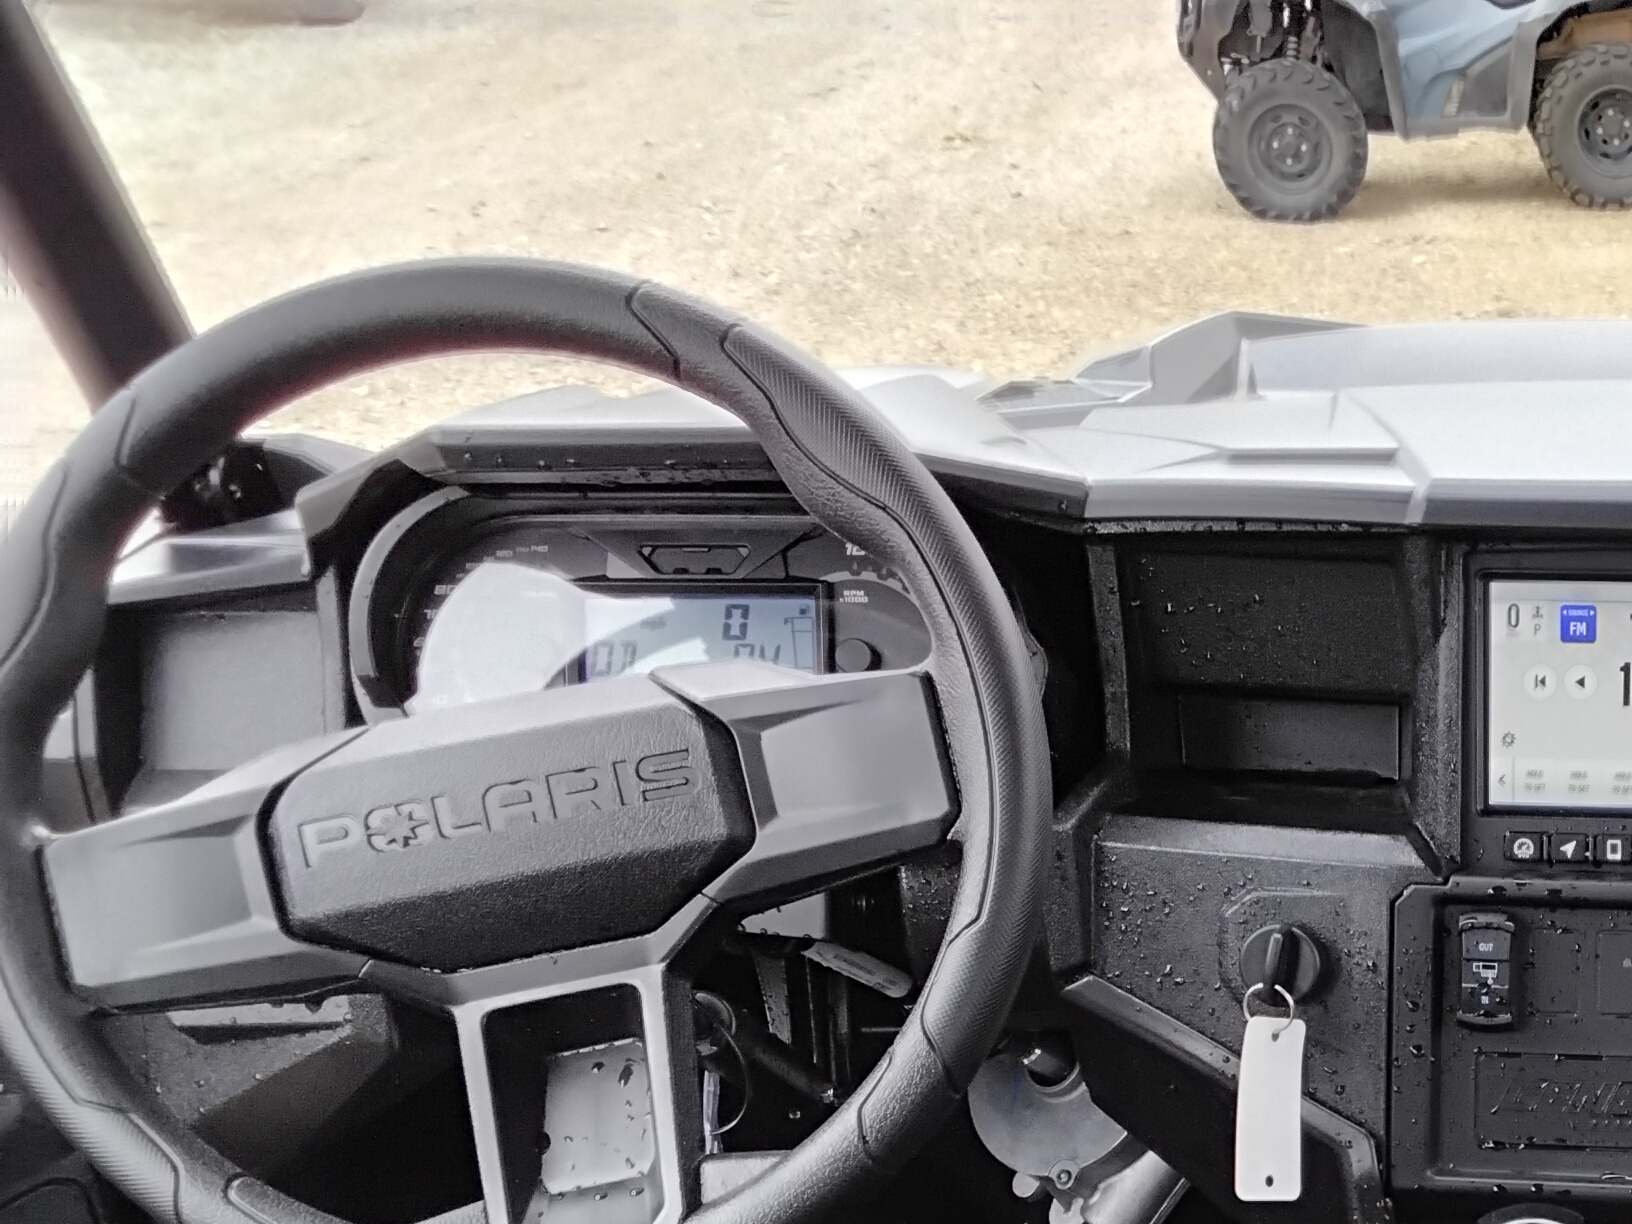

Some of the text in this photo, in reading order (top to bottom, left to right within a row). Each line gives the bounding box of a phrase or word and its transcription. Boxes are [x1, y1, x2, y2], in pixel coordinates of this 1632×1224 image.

[722, 604, 750, 640] 0
[1507, 603, 1520, 628] 0
[1534, 624, 1541, 635] P
[1569, 622, 1587, 635] FM
[298, 748, 698, 869] POLARIS
[1479, 943, 1493, 951] OUT
